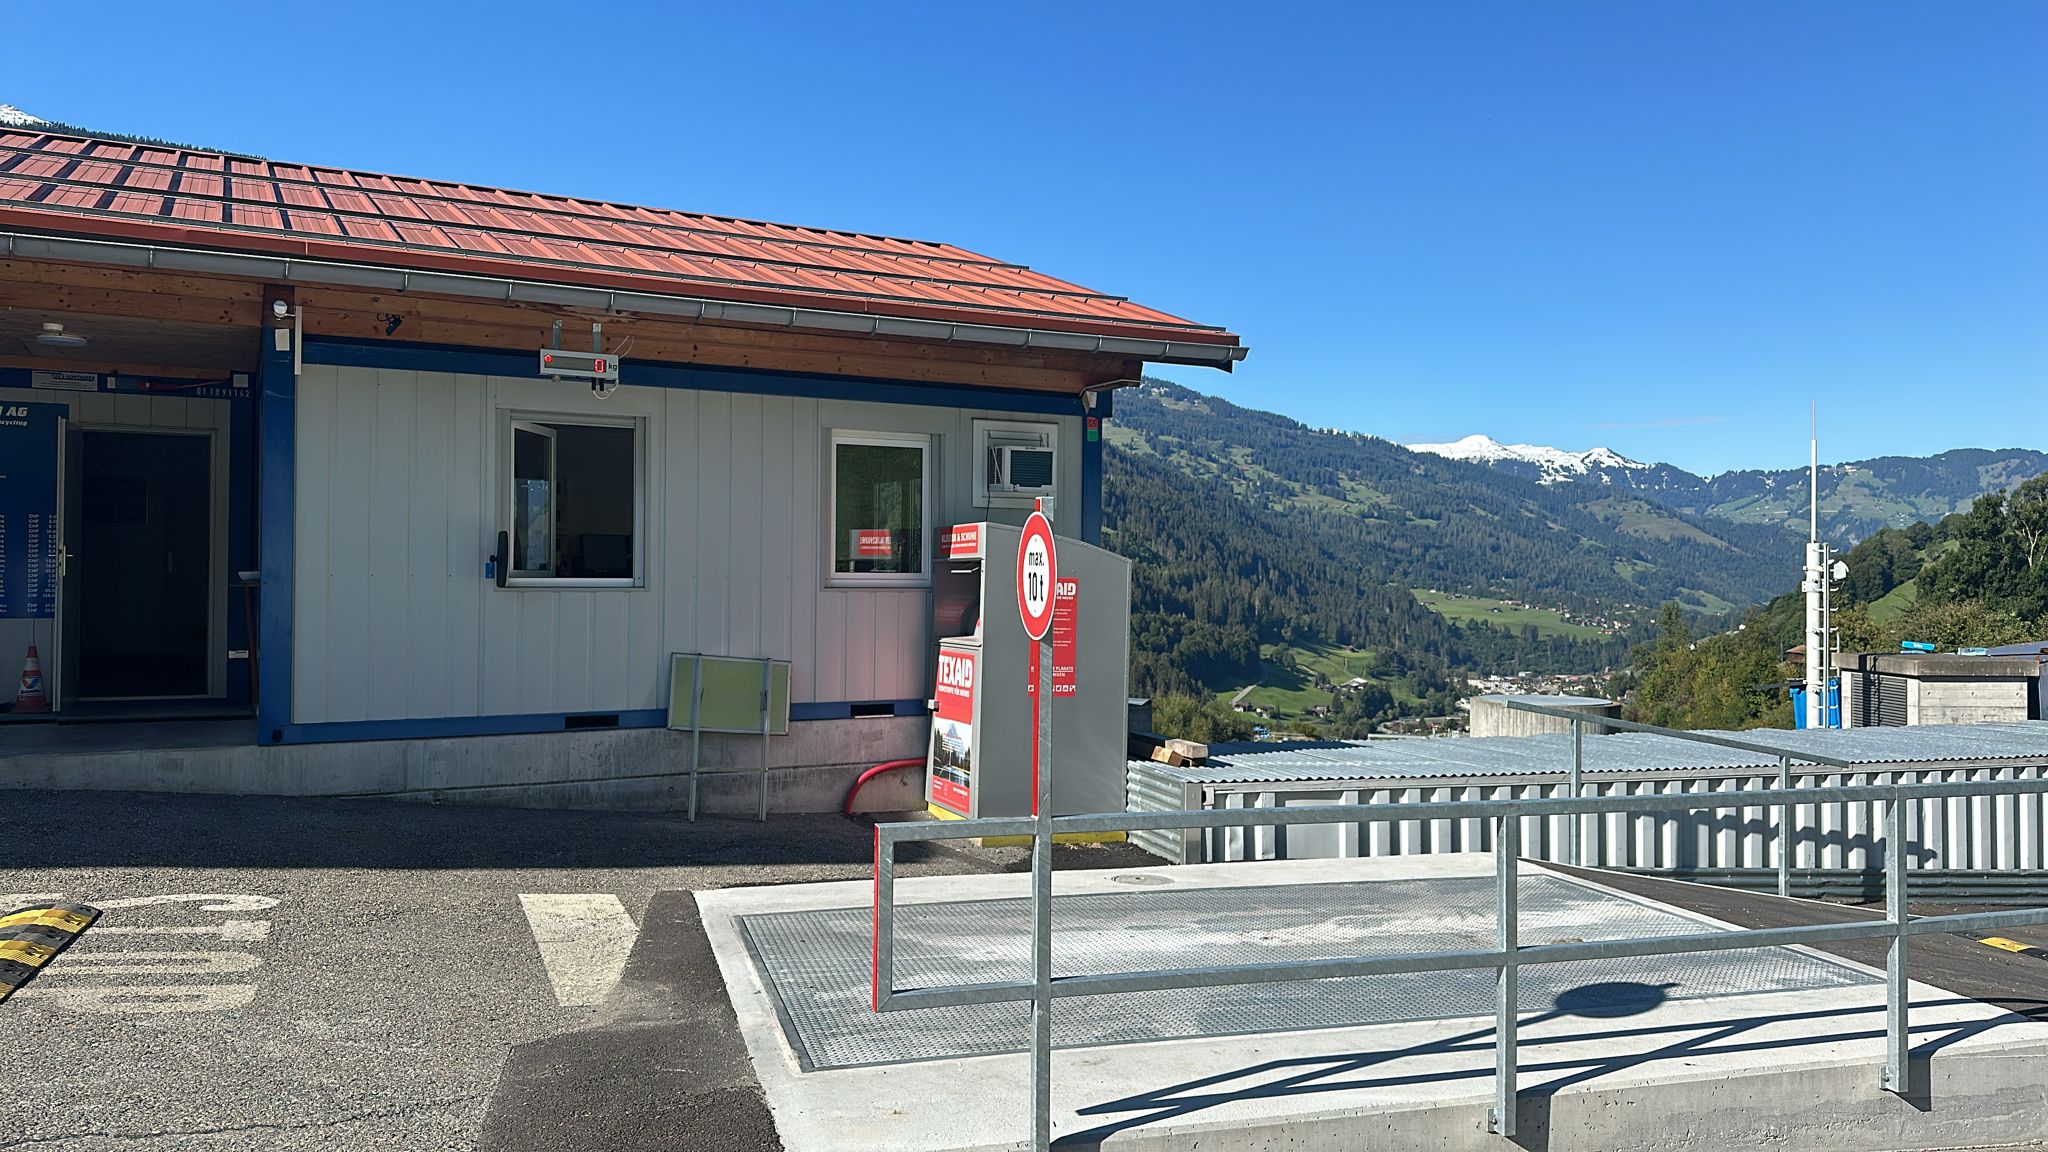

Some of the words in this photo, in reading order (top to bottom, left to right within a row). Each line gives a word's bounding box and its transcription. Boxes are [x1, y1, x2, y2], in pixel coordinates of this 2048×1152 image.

[594, 359, 604, 373] 0
[608, 363, 618, 371] kg
[6, 406, 28, 417] AG
[0, 419, 28, 427] ecycling
[1028, 552, 1044, 566] max.
[1028, 572, 1038, 602] 10
[1040, 574, 1044, 602] t
[1056, 582, 1076, 596] AID
[938, 655, 972, 688] TEXAID
